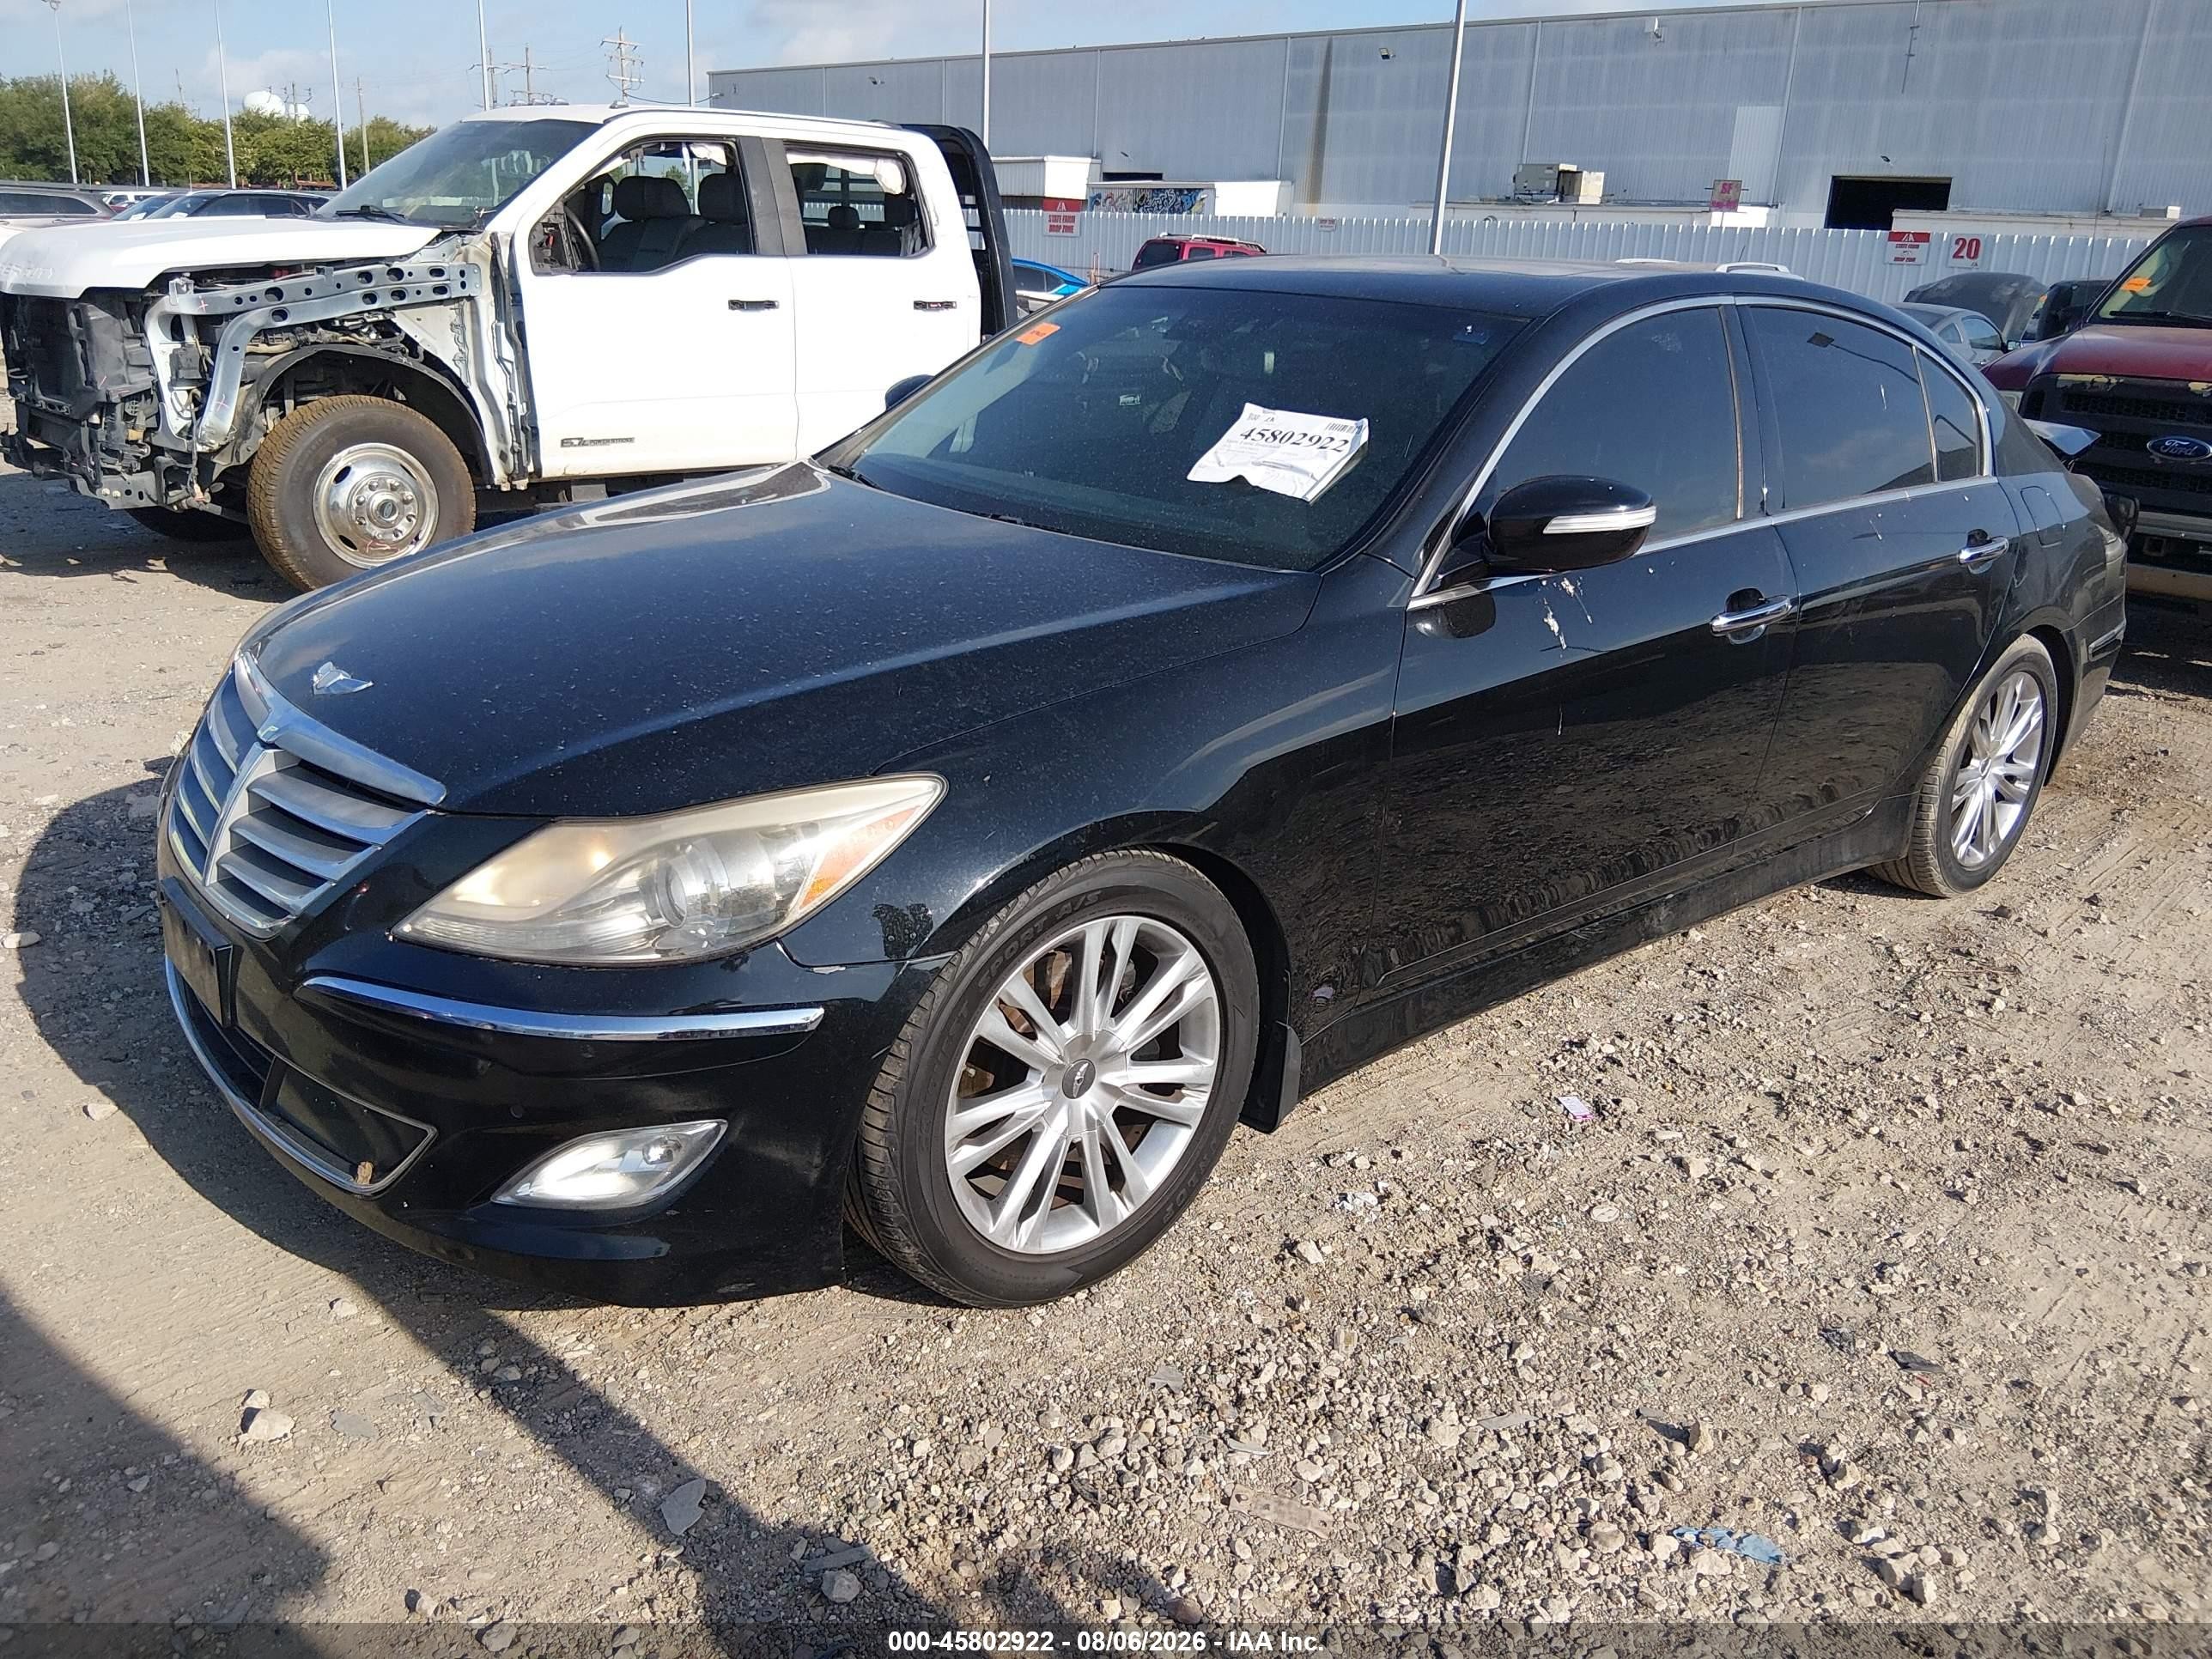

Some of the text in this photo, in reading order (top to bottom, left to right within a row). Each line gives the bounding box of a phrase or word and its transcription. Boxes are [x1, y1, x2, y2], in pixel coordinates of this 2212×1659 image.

[1953, 238, 1981, 259] 20
[1240, 427, 1349, 453] 45802922
[2160, 439, 2198, 455] Ford
[978, 916, 1048, 988] SPORT
[1055, 890, 1102, 921] A/S
